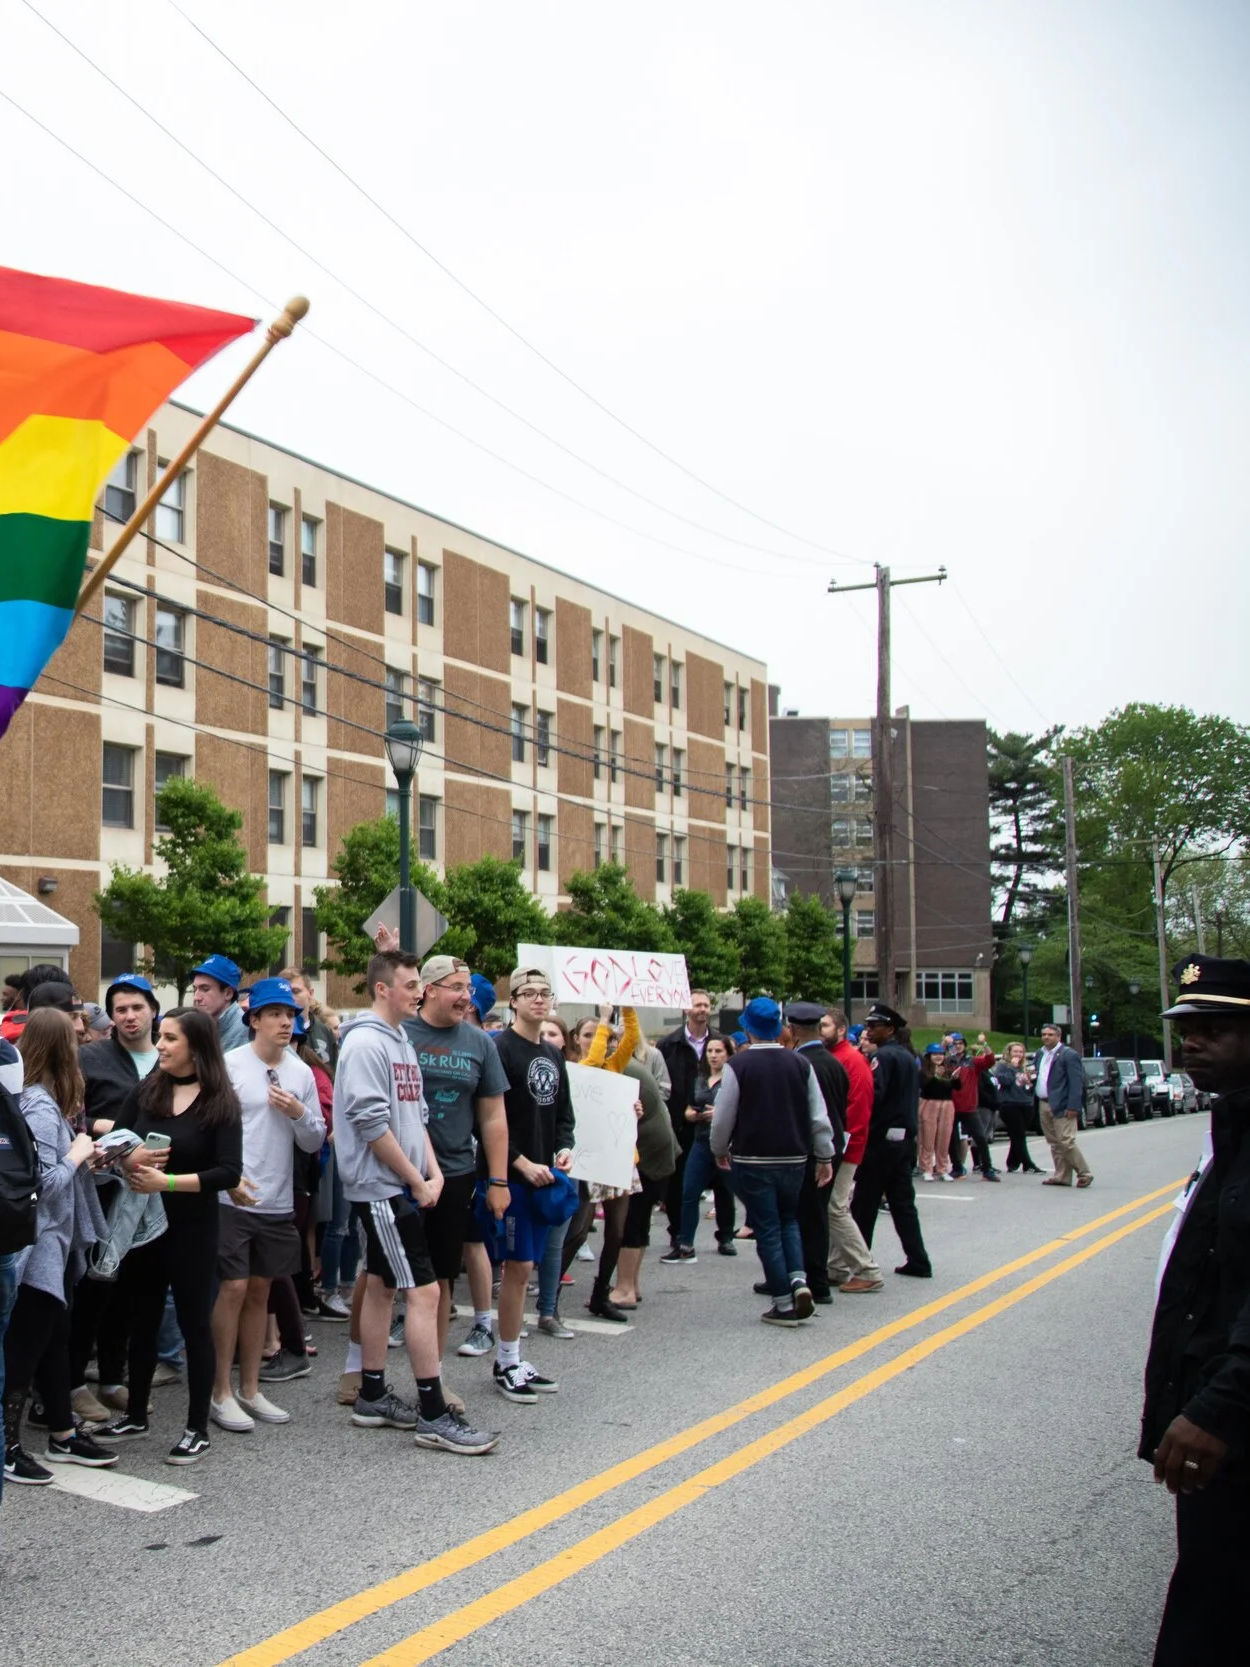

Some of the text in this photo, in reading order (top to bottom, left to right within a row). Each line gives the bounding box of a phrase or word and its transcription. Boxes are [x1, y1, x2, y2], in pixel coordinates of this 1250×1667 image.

[562, 955, 633, 998] GOD
[419, 1052, 438, 1067] 5k
[439, 1055, 471, 1071] RUN
